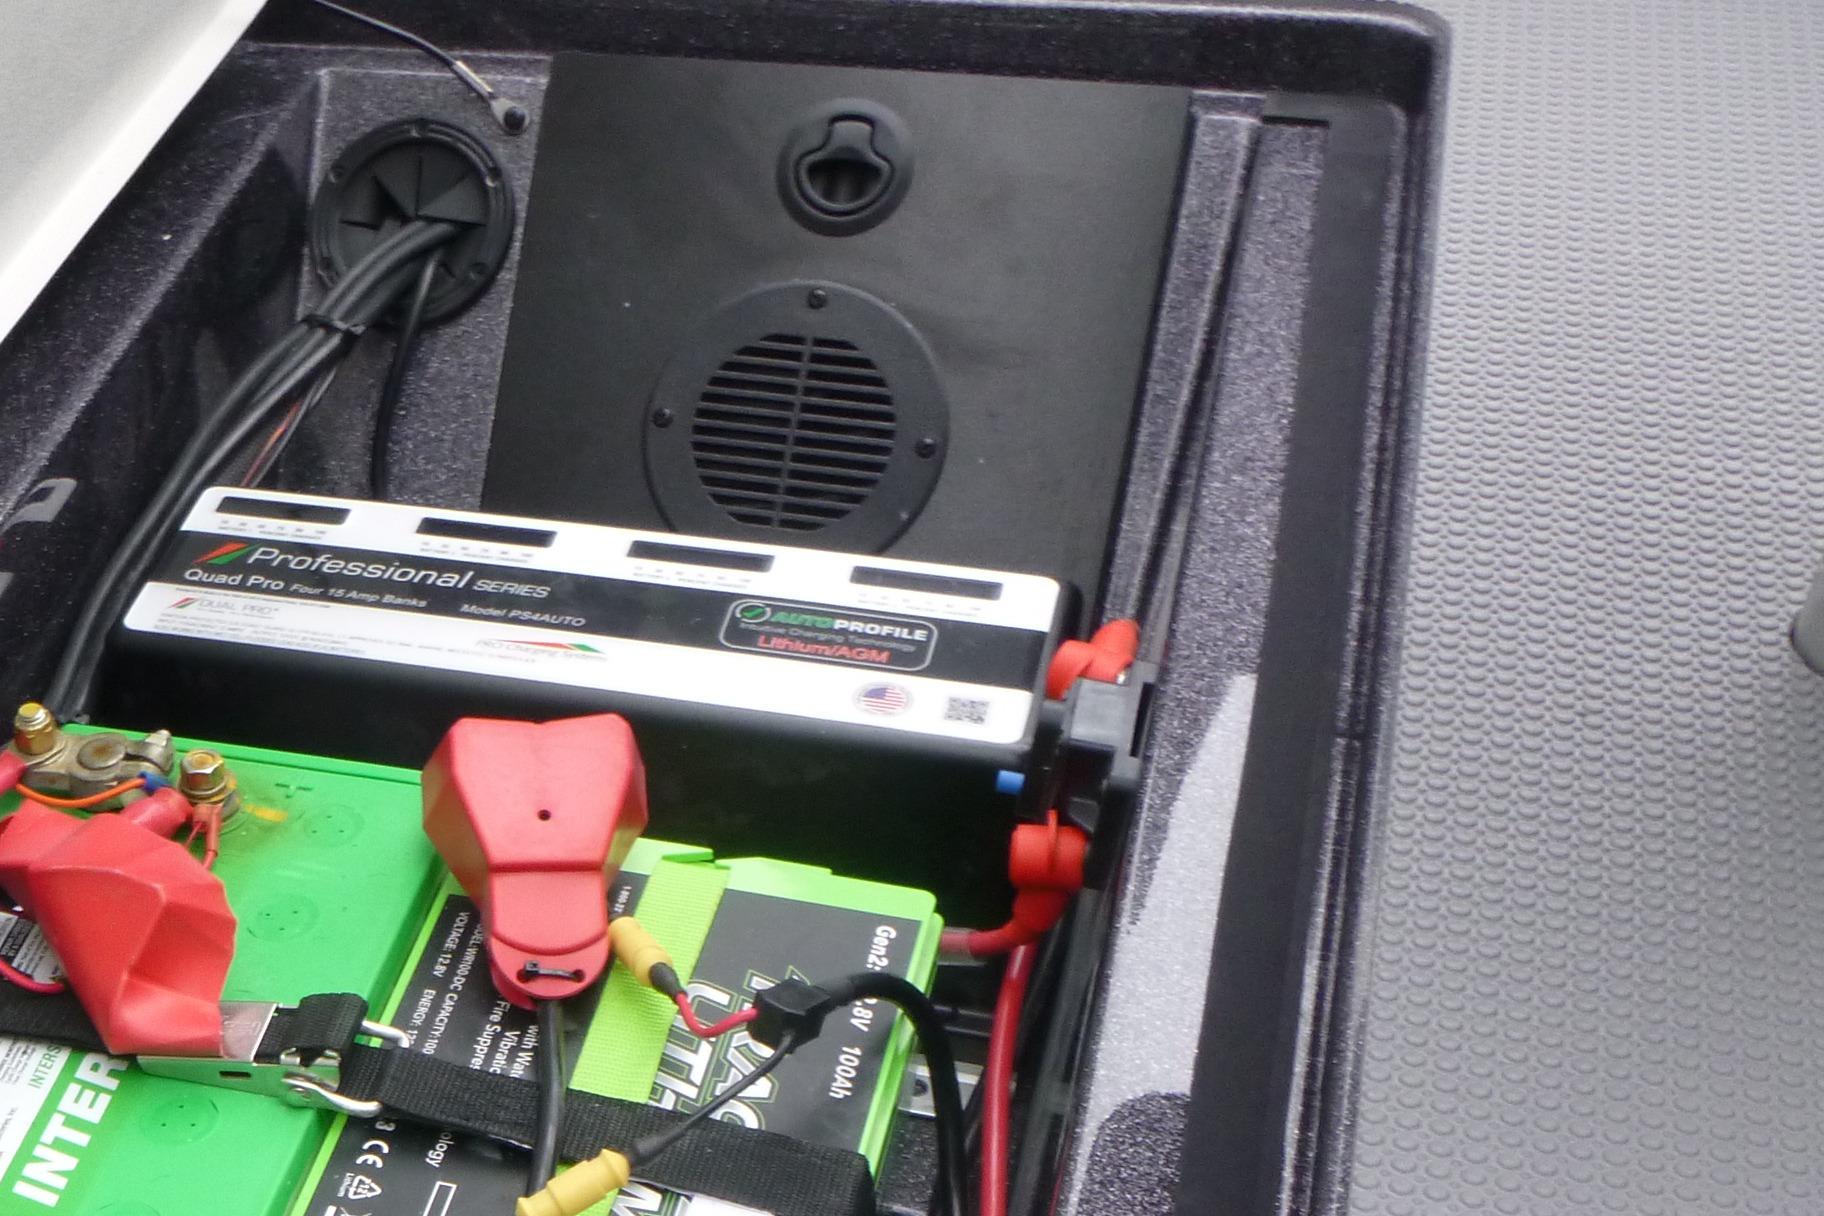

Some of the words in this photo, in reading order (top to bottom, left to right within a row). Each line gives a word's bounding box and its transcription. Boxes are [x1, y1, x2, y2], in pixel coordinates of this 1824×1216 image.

[185, 569, 242, 585] Quad
[246, 574, 285, 590] Pro
[288, 582, 323, 596] Four
[345, 590, 380, 604] Amp
[382, 595, 426, 607] Banks
[250, 548, 472, 586] Professional
[473, 580, 550, 597] SERIES
[459, 602, 506, 618] Model
[758, 637, 888, 662] Lithium/AGM
[444, 913, 467, 951] VOLTAGE:
[867, 926, 896, 970] Gen2:
[433, 955, 451, 977] 12.8V
[412, 990, 435, 1025] ENERGY:
[489, 1001, 509, 1022] Fire
[521, 1026, 538, 1048] with
[830, 1047, 861, 1098] 100Ah
[15, 1053, 127, 1206] INTER
